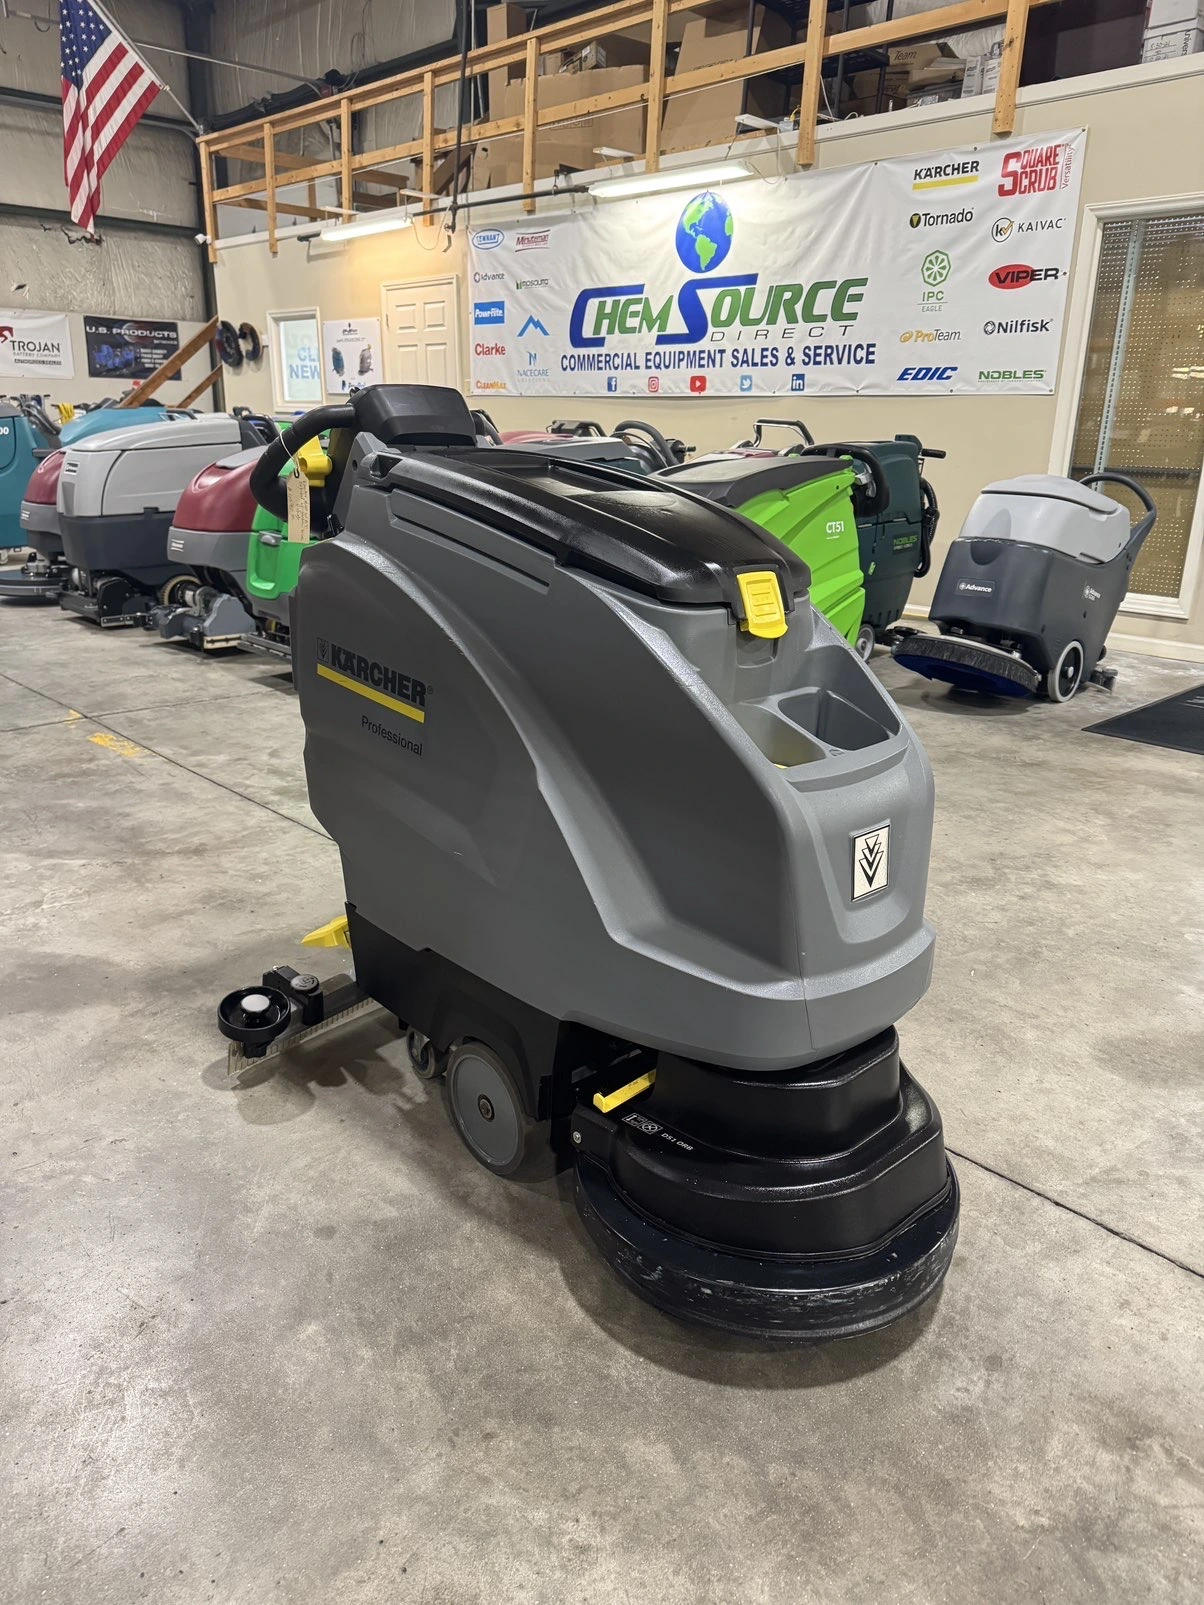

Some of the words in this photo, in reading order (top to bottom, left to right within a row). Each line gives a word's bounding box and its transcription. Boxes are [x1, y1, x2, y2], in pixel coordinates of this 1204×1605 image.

[913, 160, 980, 181] KÄRCHER
[921, 207, 974, 228] Tornado
[1018, 218, 1063, 233] KAIVAC
[994, 267, 1060, 284] VIPER
[922, 290, 944, 302] IPC
[921, 305, 943, 313] EAGLE
[86, 326, 110, 335] U.S.
[112, 327, 177, 339] PRODUCTS
[710, 324, 854, 342] DIRECT
[997, 319, 1050, 334] Nilfisk
[913, 329, 961, 343] ProTeam
[9, 340, 61, 353] TROJAN
[474, 343, 506, 356] Clarke
[560, 352, 641, 372] COMMERCIAL
[644, 348, 726, 371] EQUIPMENT
[730, 346, 779, 368] SALES
[784, 346, 796, 367] &
[801, 343, 877, 366] SERVICE
[896, 366, 959, 382] EDIC
[978, 369, 1045, 380] NOBLES
[825, 520, 845, 534] CT51
[965, 583, 993, 593] Advance
[330, 643, 427, 707] KÄRCHER
[361, 714, 423, 756] Professional
